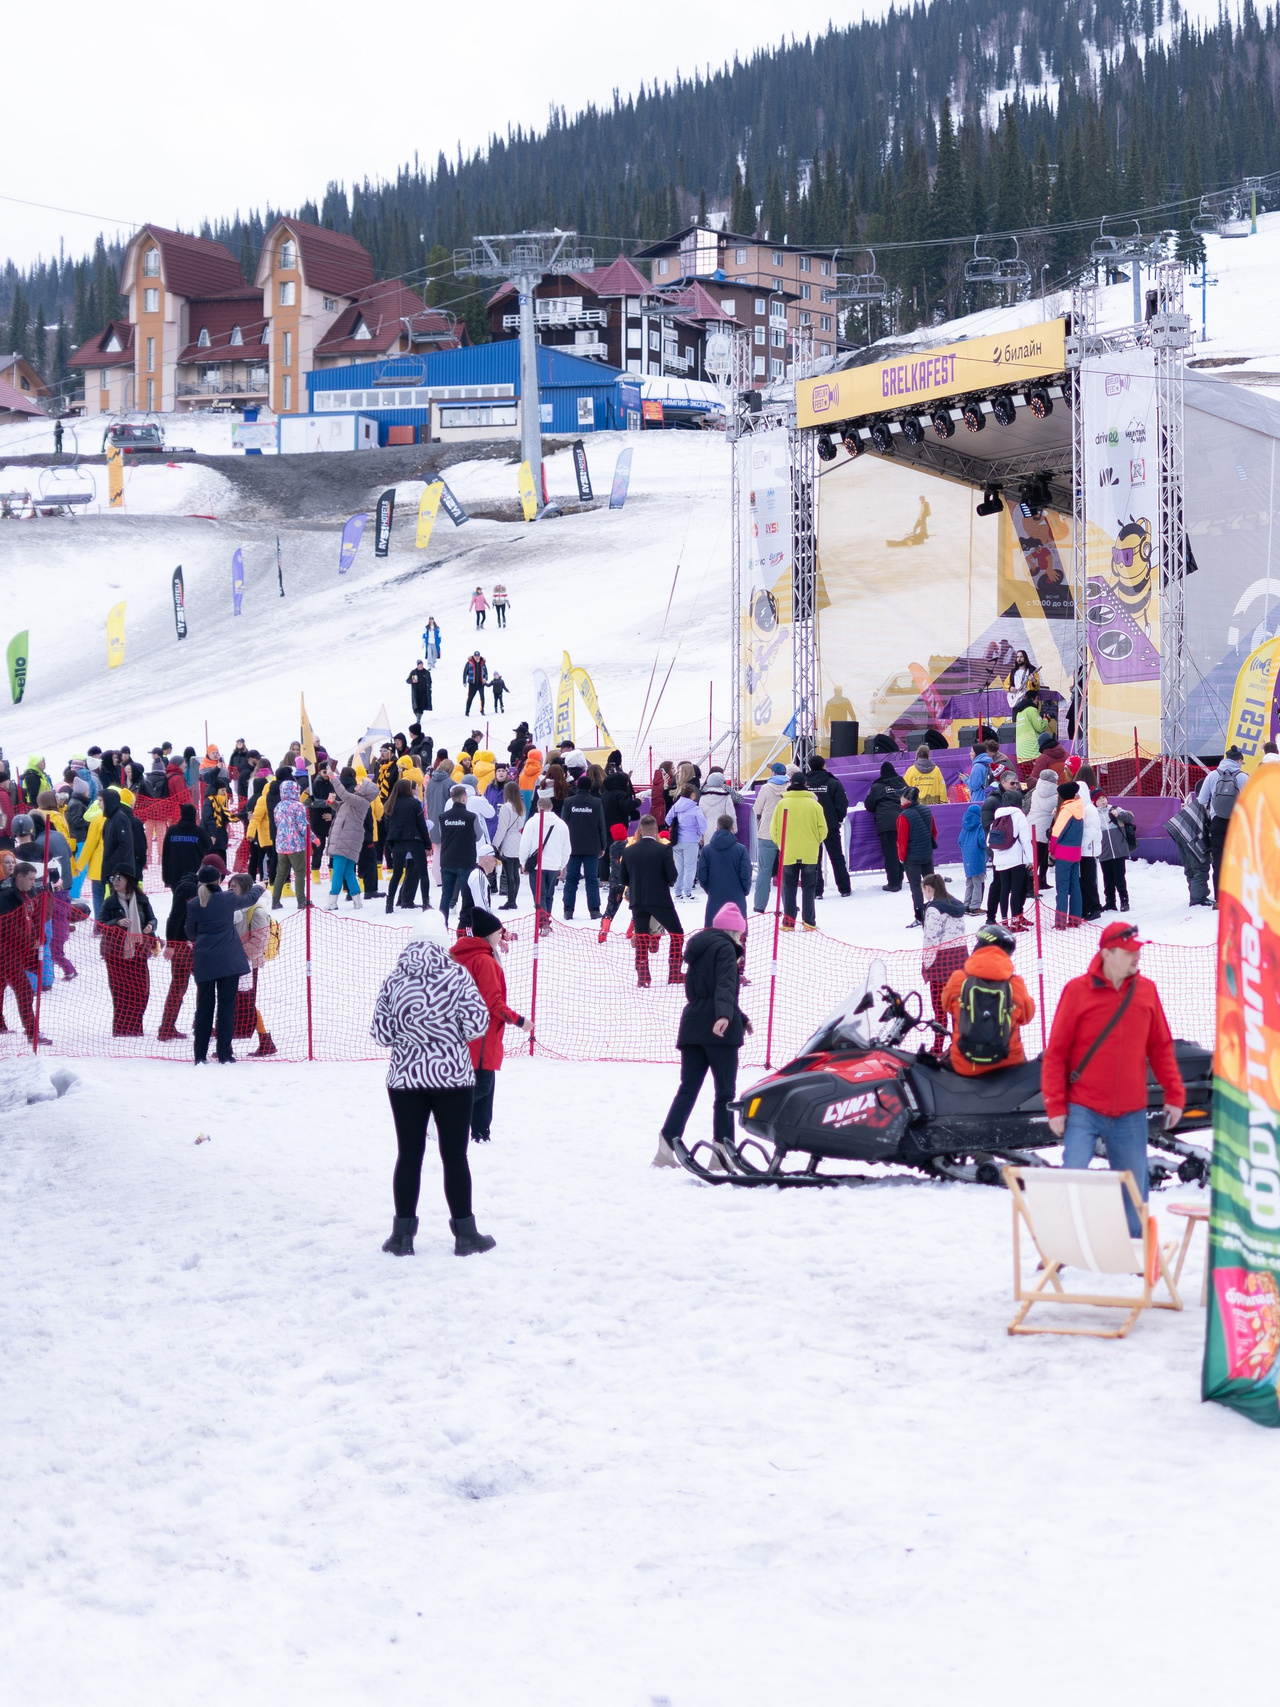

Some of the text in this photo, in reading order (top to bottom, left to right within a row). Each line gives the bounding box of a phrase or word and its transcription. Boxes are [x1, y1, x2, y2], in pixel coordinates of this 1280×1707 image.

[1004, 340, 1042, 362] билайн
[882, 352, 957, 397] GRELKAFEST
[1095, 430, 1119, 445] drivee
[822, 1090, 882, 1124] LYNX
[833, 1113, 867, 1128] YETI
